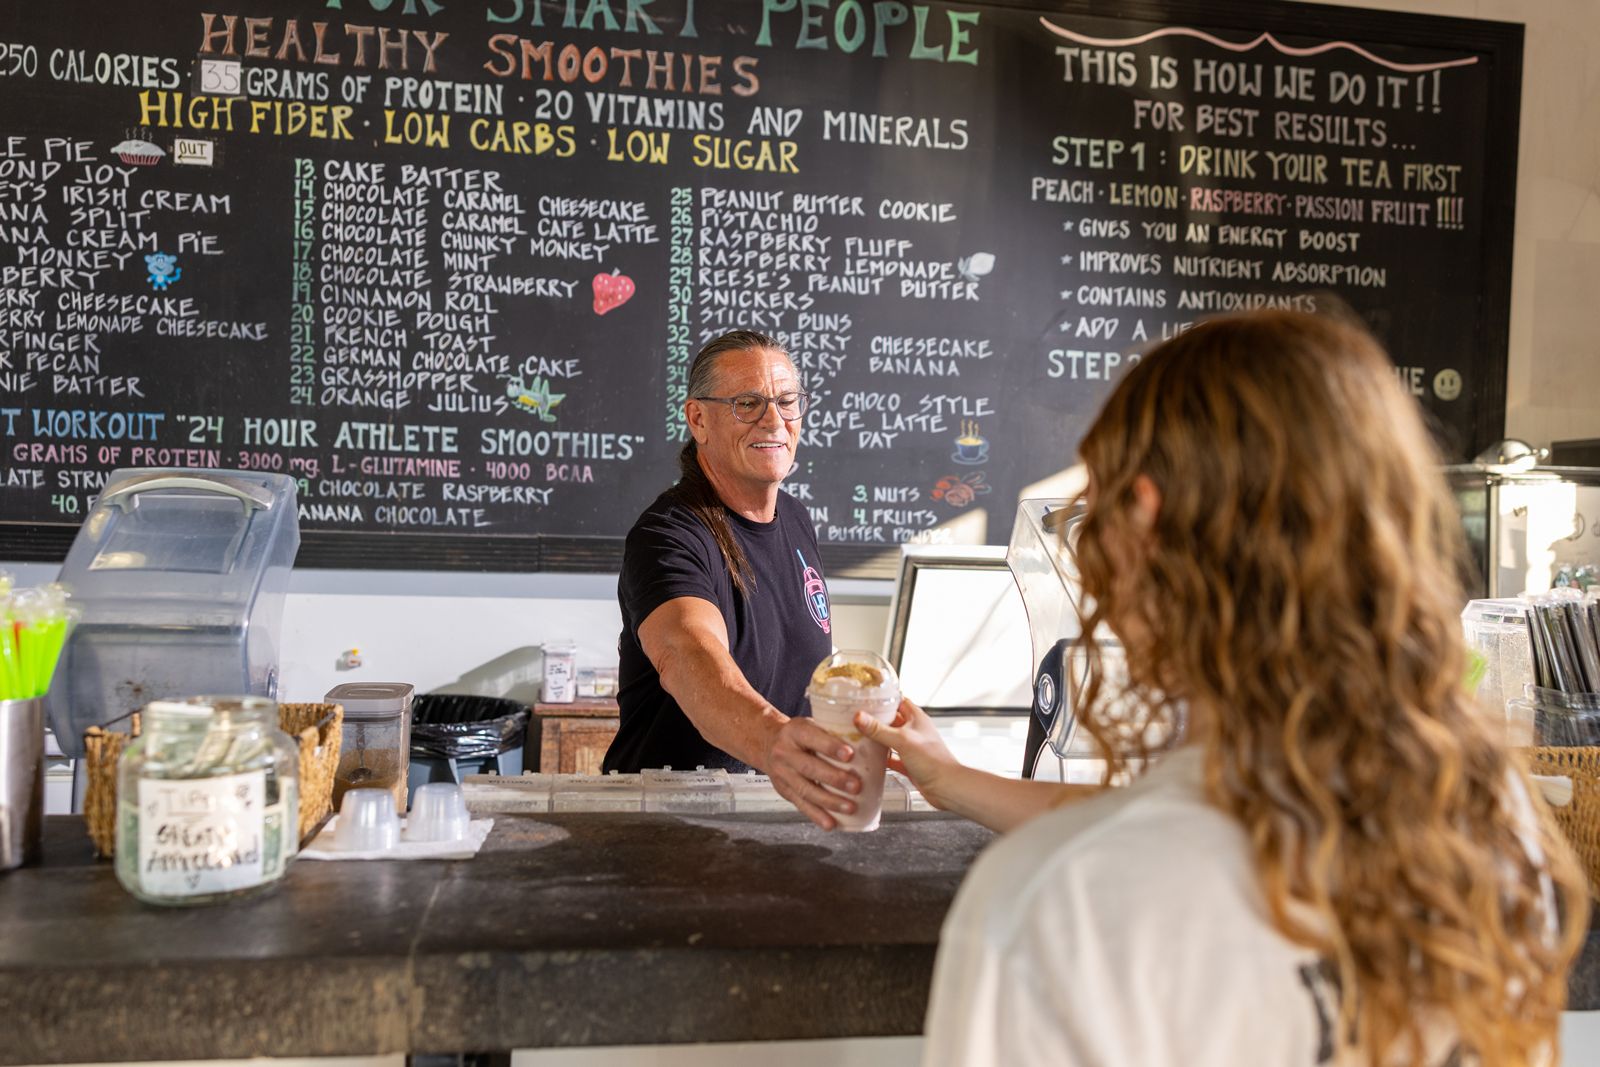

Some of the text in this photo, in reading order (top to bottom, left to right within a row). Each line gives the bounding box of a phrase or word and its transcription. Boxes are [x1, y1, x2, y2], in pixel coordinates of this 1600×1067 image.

[755, 0, 981, 66] PEOPLE
[200, 13, 760, 97] HEALTHY SMOOTHIES
[1055, 46, 1366, 105] THIS IS HOW WE DO
[50, 48, 968, 150] CALORIES 35 GRAMS OF PROTEIN 20 VITAMINS AND MINERALS
[138, 90, 800, 175] HIGH FIBER LOW CARBS LOW SUGAR
[1134, 99, 1184, 131] FOR
[1196, 104, 1260, 138] BEST
[180, 142, 208, 155] OUT
[75, 164, 138, 188] JOY
[323, 160, 385, 184] CAKE
[401, 164, 503, 192] BATTER
[1052, 135, 1462, 193] STEP DRINK YOUR TEA FIRST
[62, 186, 231, 214] IRISH CREAM
[323, 182, 430, 207] CHOCOLATE
[443, 190, 526, 214] CARAMEL
[538, 196, 649, 222] CHEESECAKE
[700, 187, 784, 211] PEANUT
[793, 193, 865, 217] BUTTER
[879, 198, 957, 223] COOKIE
[1031, 177, 1430, 226] PEACH LEMON RASPBERRY PASSION FRUIT
[321, 202, 428, 227] CHOCOLATE
[442, 212, 528, 235] CARAMEL
[537, 217, 585, 239] CAFE
[594, 222, 660, 243] LATTE
[1079, 218, 1360, 252] GIVES YOU AN ENERGY BOOST
[66, 230, 158, 252] CREAM
[321, 222, 427, 248] CHOCOLATE
[441, 231, 517, 255] CHUNKY
[530, 238, 610, 264] MONKEY
[700, 227, 832, 254] RASPBERRY
[845, 236, 913, 258] FLUFF
[18, 246, 133, 270] MONKEY
[321, 243, 429, 269] CHOCOLATE
[443, 252, 496, 272] MINT
[699, 247, 831, 271] RASPBERRY
[845, 257, 956, 280] LEMONADE
[1080, 251, 1386, 288] IMPROVES NUTRIENT ABSORPTION
[320, 263, 432, 289] CHOCOLATE
[448, 271, 579, 299] STRAWBERRY
[698, 267, 791, 290] REESE'S
[808, 273, 884, 296] PEANUT
[900, 279, 980, 301] BUTTER
[58, 292, 200, 317] CHEESECAKE
[320, 284, 431, 311] CINNAMON
[445, 291, 498, 314] ROLL
[699, 287, 815, 310] SNICKERS
[1077, 285, 1316, 314] CONTAINS ANTIOXIDANTS
[56, 311, 268, 340] LEMONADE CHEESECAKE
[323, 306, 402, 327] COOKIE
[416, 311, 490, 333] DOUGH
[699, 306, 852, 332] STICKY BUNS
[1075, 317, 1148, 341] ADD A
[423, 331, 496, 353] TOAST
[871, 336, 993, 359] CHEESECAKE
[26, 352, 100, 375] PECAN
[323, 346, 401, 369] GERMAN
[412, 350, 510, 372] CHOCOLATE
[525, 355, 583, 378] CAKE
[869, 357, 960, 376] BANANA
[1048, 349, 1120, 380] STEP
[53, 375, 145, 398] BATTER
[321, 366, 479, 393] GRASSHOPPER
[320, 386, 411, 410] ORANGE
[428, 392, 509, 416] JULIUS
[842, 391, 994, 417] CHOCO STYLE
[32, 409, 165, 440] WORKOUT
[243, 417, 319, 447] HOUR
[334, 421, 458, 453] ATHLETE
[807, 410, 947, 433] CAFE LATTE
[859, 431, 899, 448] DAY
[13, 443, 88, 464] GRAMS
[98, 446, 121, 465] OF
[131, 447, 220, 468] PROTEIN
[238, 451, 283, 469] 3000
[290, 457, 320, 479] mg
[486, 461, 531, 480] 4000
[546, 463, 594, 483] BCAA
[319, 480, 554, 506] CHOCOLATE RASPBERRY
[874, 486, 920, 503] NUTS
[375, 505, 492, 527] CHOCOLATE
[828, 525, 885, 542] BUTTER
